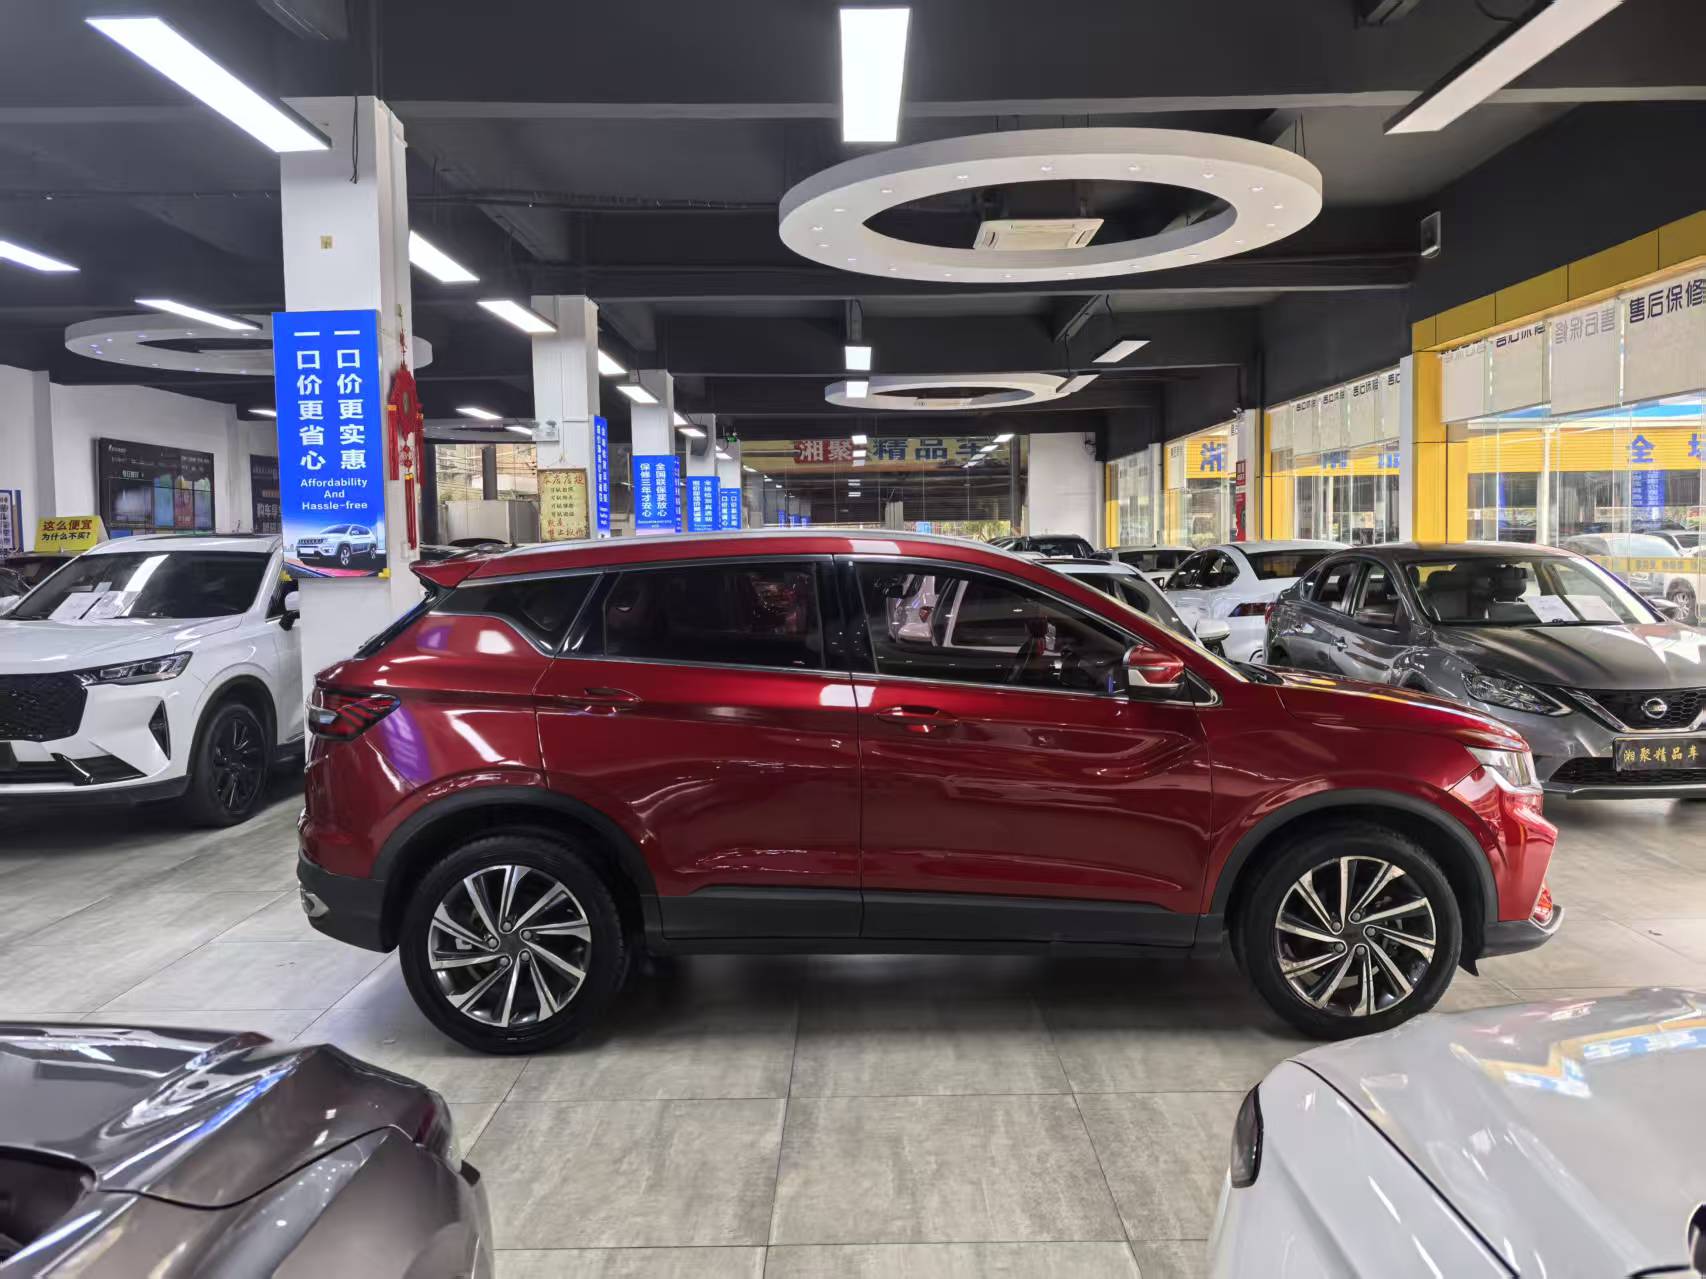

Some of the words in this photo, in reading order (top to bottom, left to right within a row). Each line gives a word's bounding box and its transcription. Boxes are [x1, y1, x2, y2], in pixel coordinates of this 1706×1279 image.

[1628, 278, 1706, 325] 售后保修
[293, 330, 327, 472] 一口价更省心
[333, 329, 367, 470] 一口价更实惠
[300, 478, 368, 488] Affordability
[323, 490, 345, 498] And
[640, 462, 652, 518] 保修三年才安心
[302, 501, 369, 510] Hassle-free
[43, 519, 93, 532] 这么便宜
